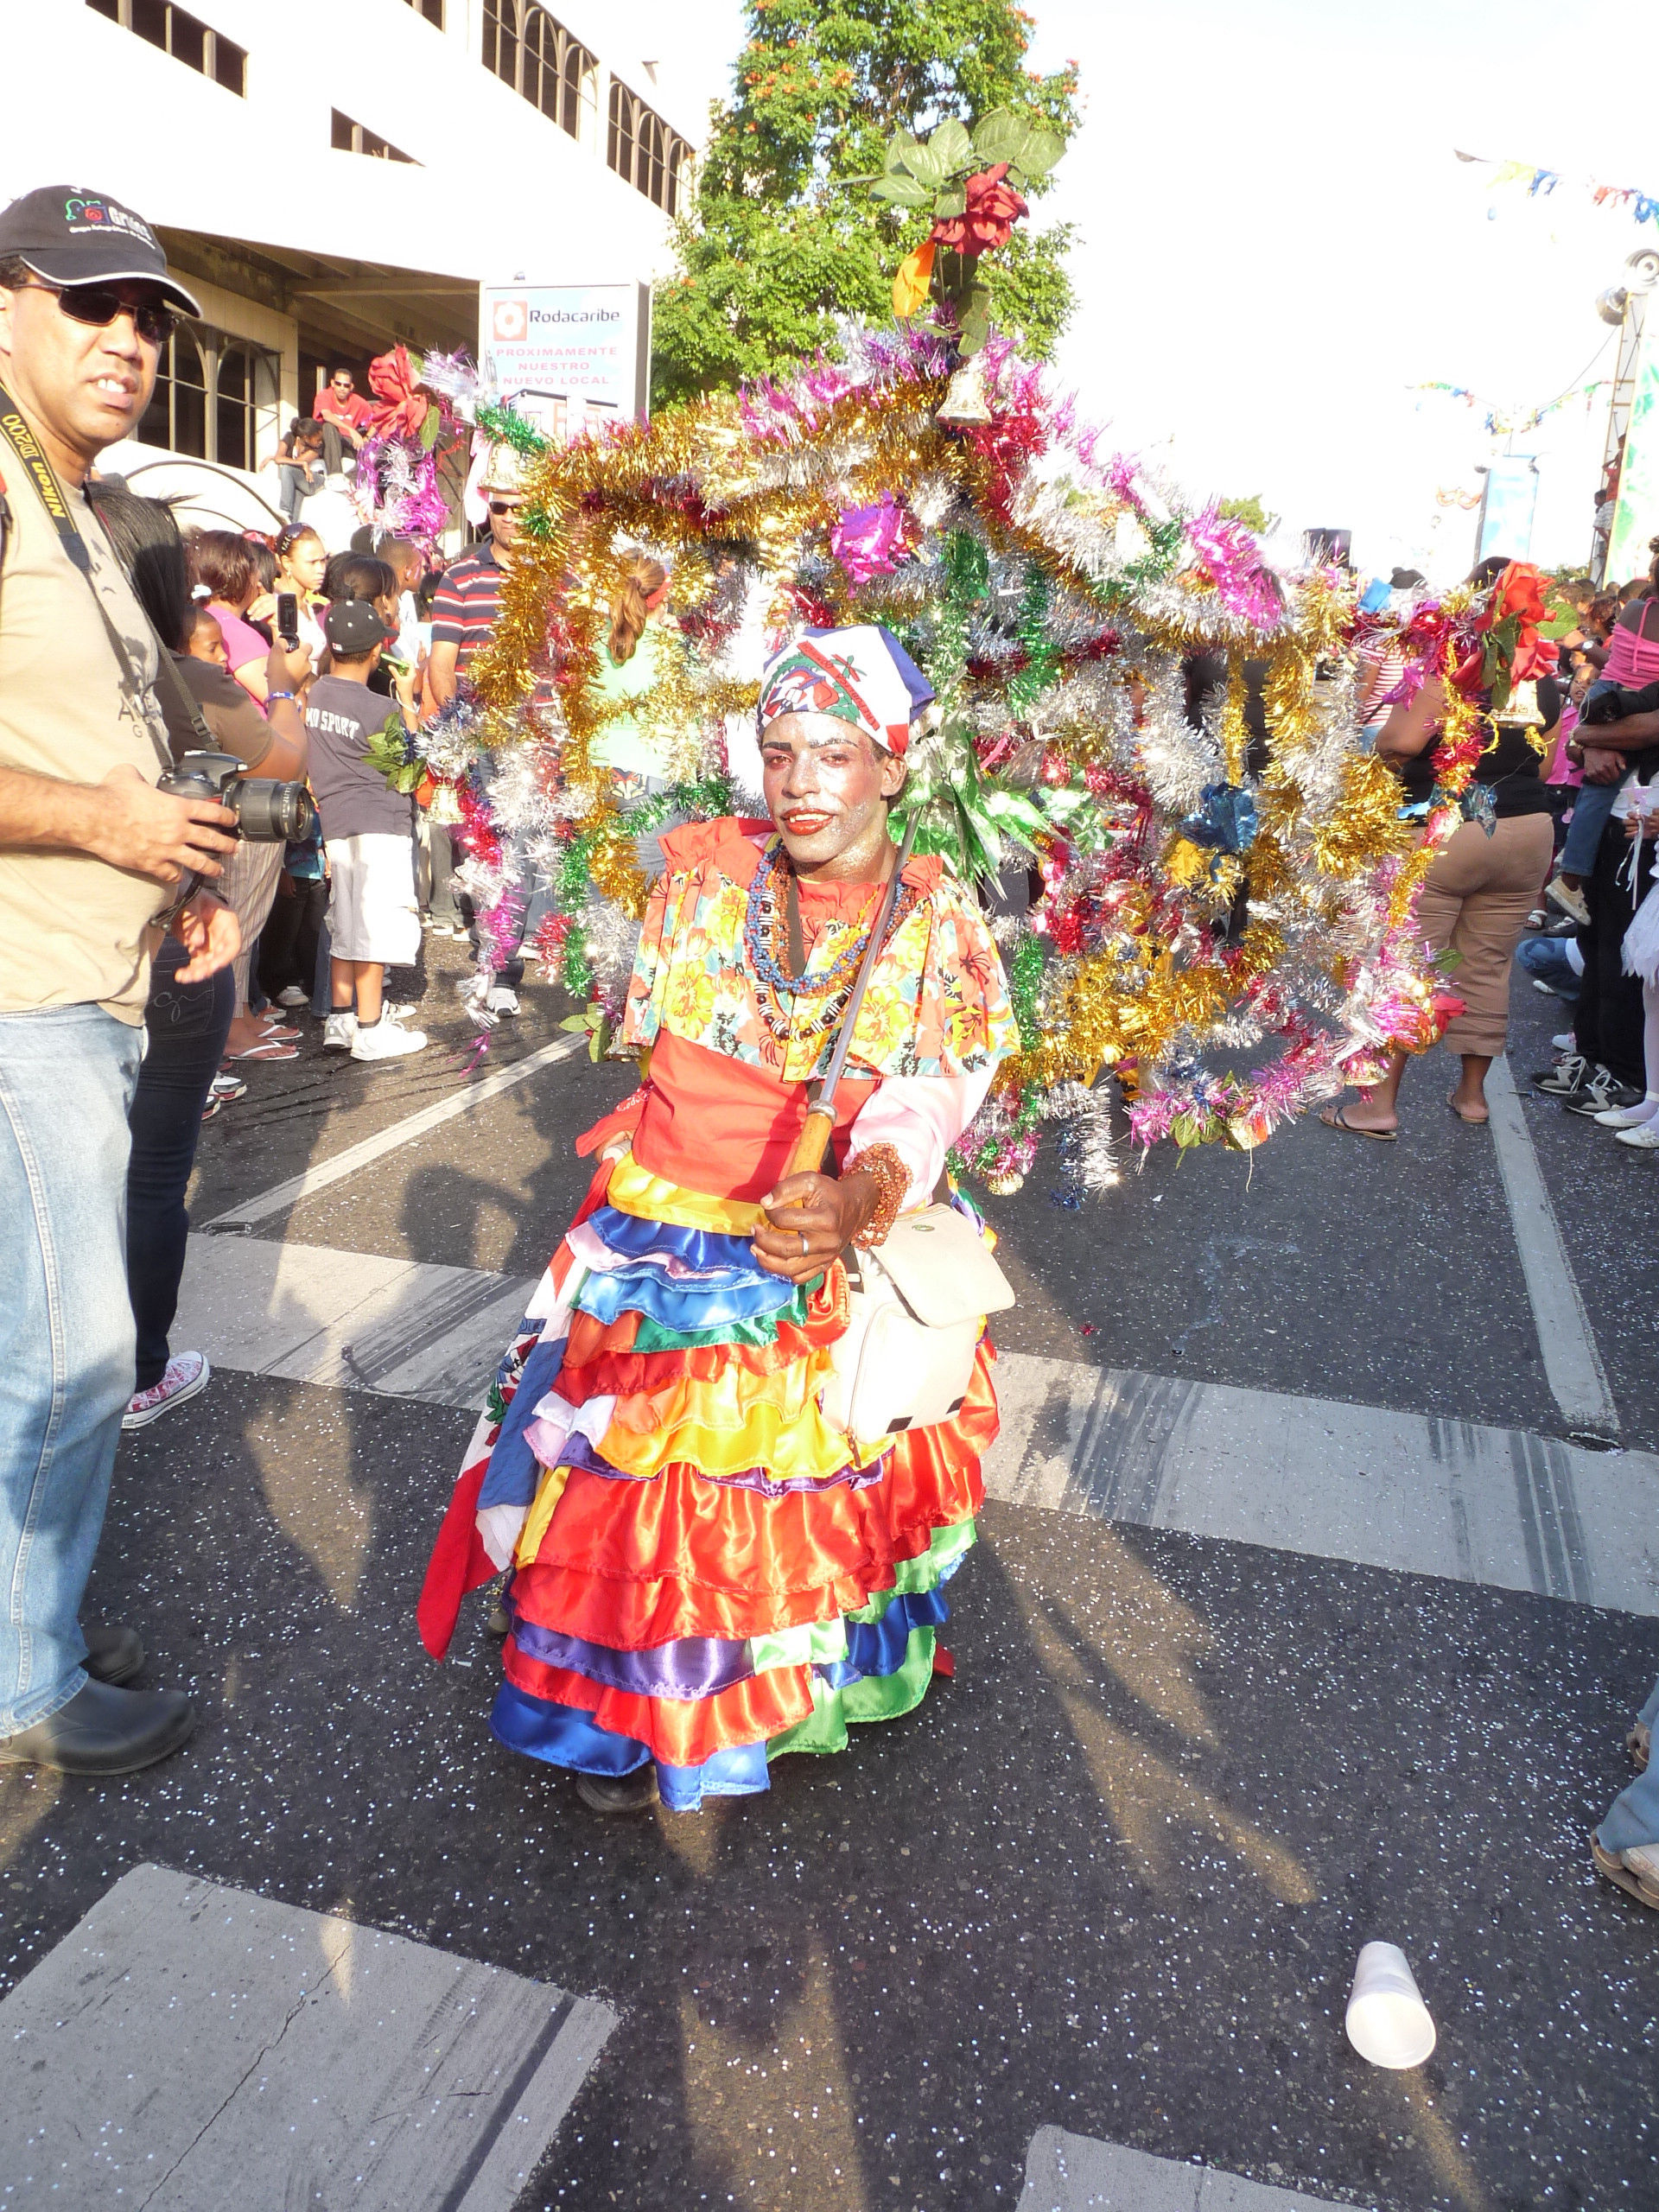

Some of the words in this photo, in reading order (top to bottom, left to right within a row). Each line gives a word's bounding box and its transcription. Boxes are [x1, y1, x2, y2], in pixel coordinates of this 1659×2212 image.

[530, 308, 620, 323] Rodacaribe
[496, 347, 617, 357] PROXIMAMENTE
[518, 361, 590, 371] NUESTRO
[560, 377, 609, 385] LOCAL
[2, 414, 40, 459] D200
[32, 461, 67, 518] Nikon
[321, 710, 360, 740] SPORT
